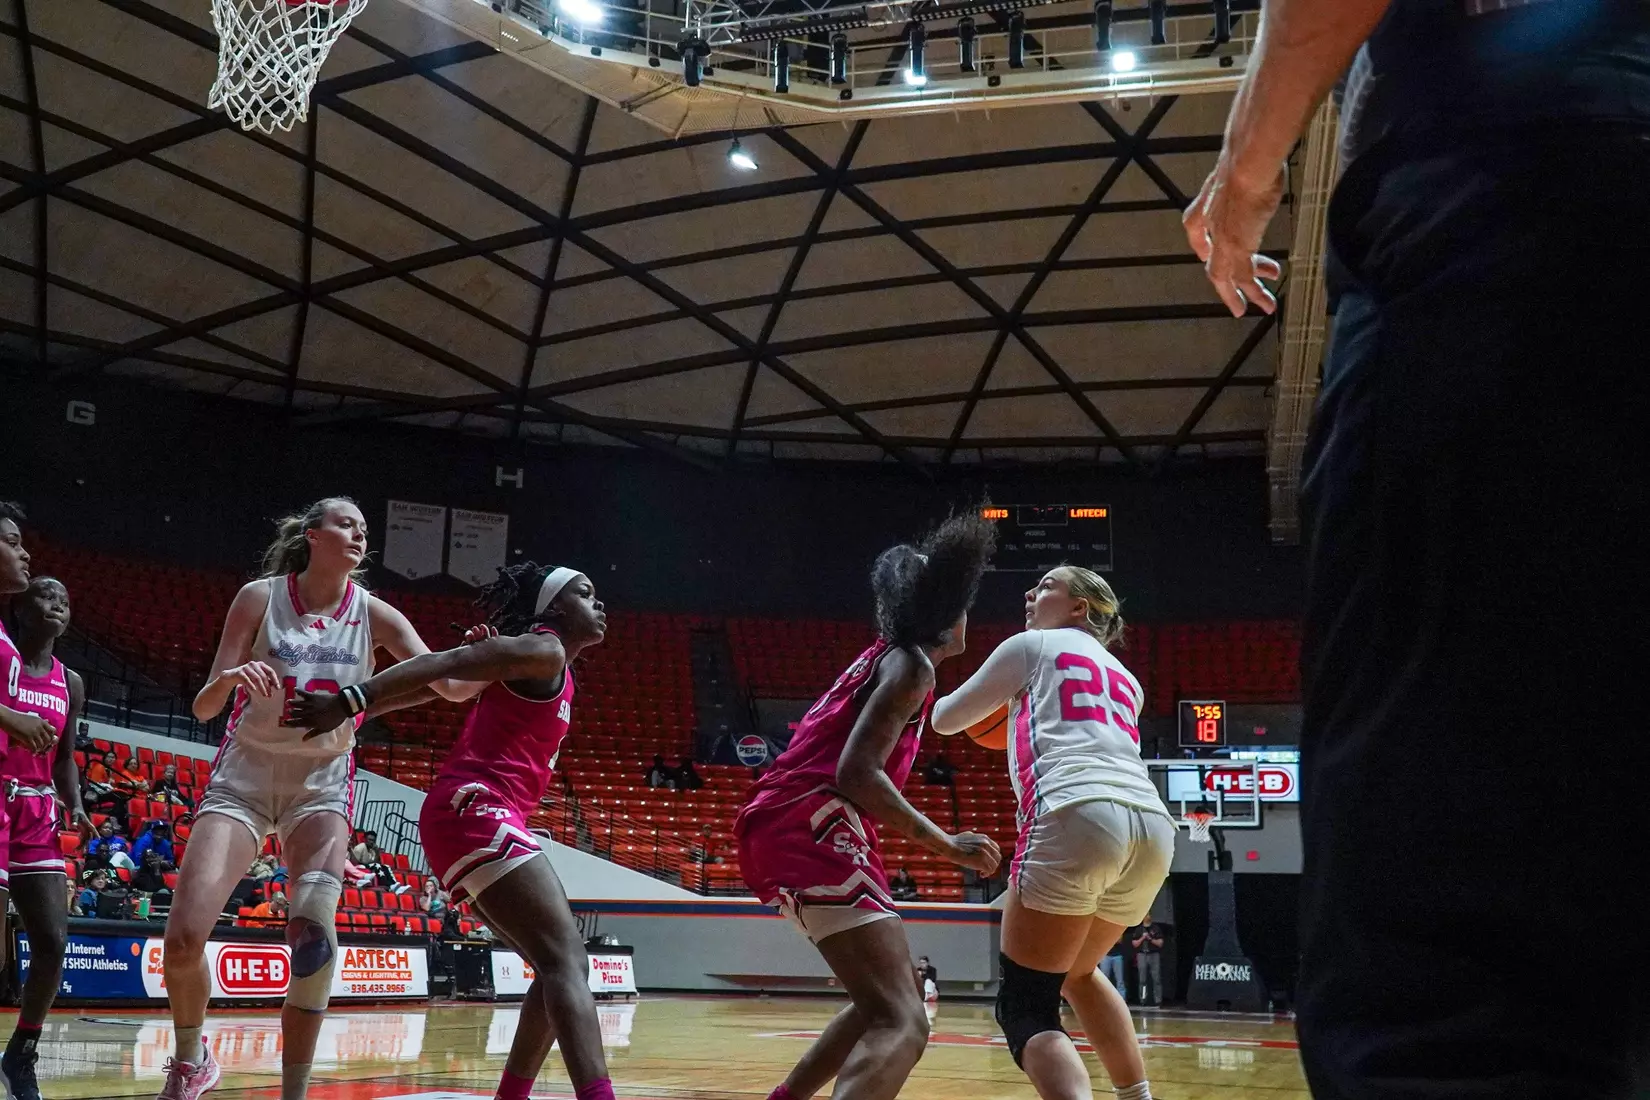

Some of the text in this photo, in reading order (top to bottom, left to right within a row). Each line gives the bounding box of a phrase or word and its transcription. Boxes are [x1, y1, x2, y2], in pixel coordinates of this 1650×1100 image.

[66, 400, 96, 425] G
[496, 465, 524, 488] H
[1070, 508, 1107, 518] LATECH
[18, 688, 66, 716] HOUSTON
[1055, 652, 1140, 744] 25
[1193, 705, 1221, 719] 7:55
[1197, 720, 1217, 742] 18
[740, 747, 766, 755] PEPSI
[72, 942, 105, 955] Internet
[68, 957, 91, 970] SHSU
[92, 959, 128, 971] Athletics
[344, 948, 408, 969] ARTECH
[593, 957, 628, 970] Domino's
[602, 971, 623, 983] Pizza
[1195, 971, 1250, 981] HERMANN
